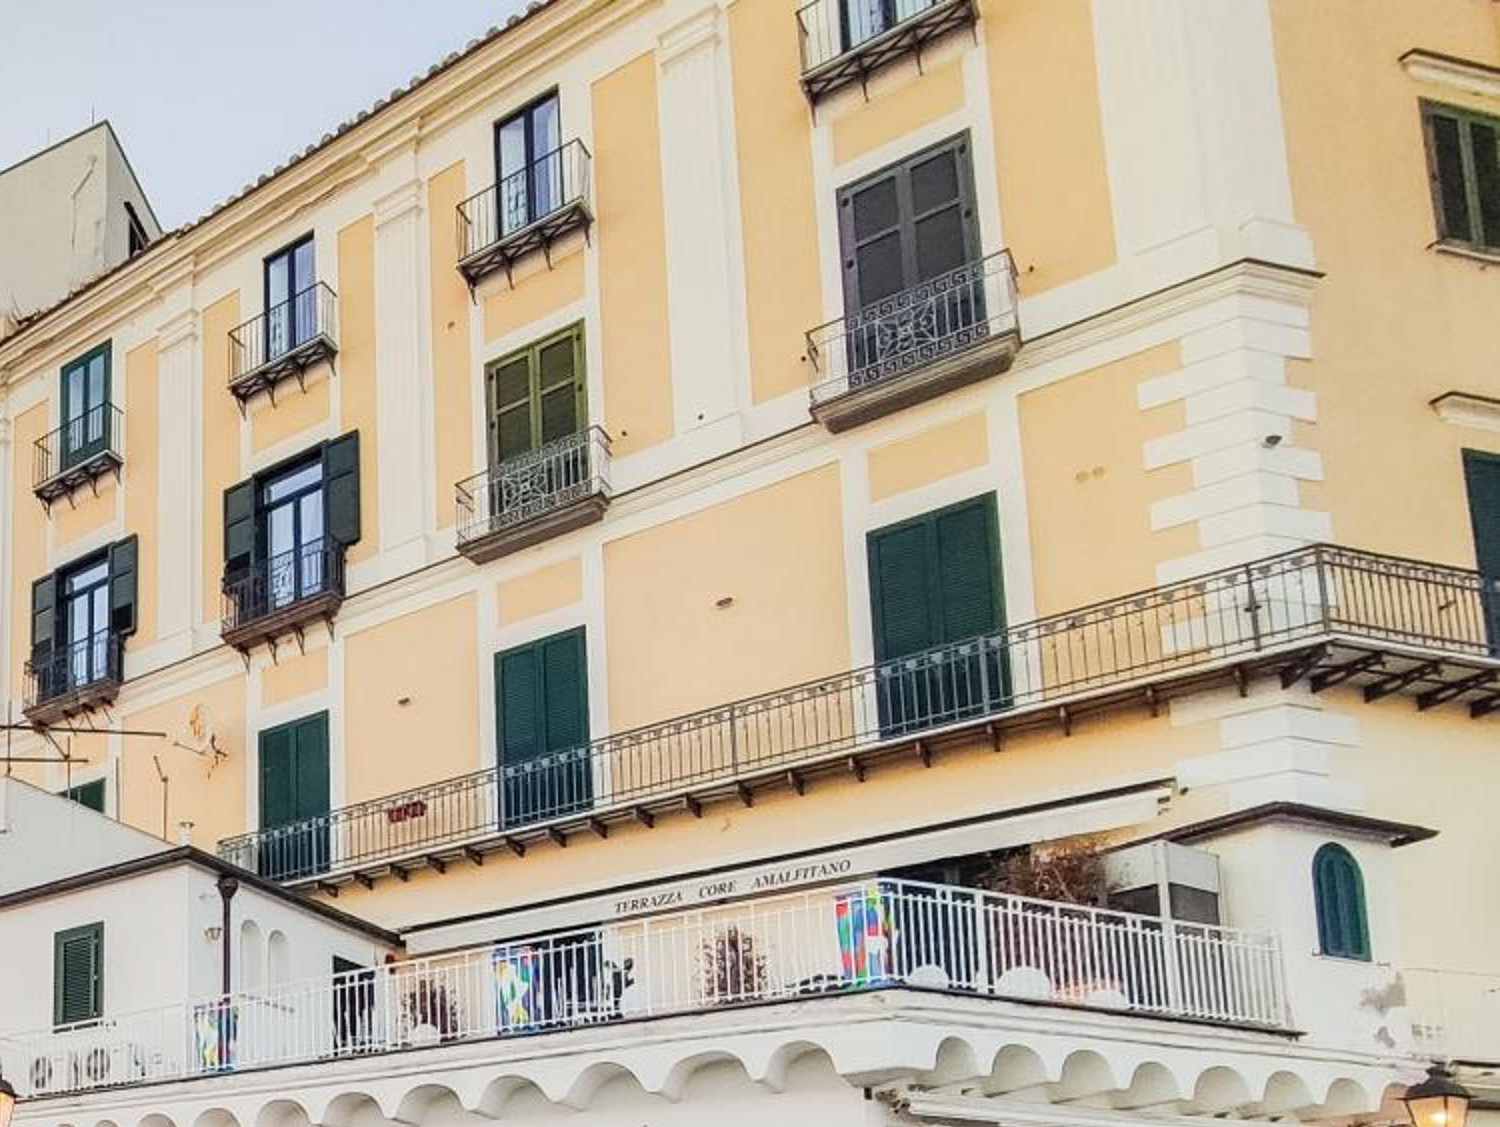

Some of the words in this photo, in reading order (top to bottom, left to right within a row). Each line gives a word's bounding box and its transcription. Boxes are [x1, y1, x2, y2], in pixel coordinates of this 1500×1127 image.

[614, 892, 682, 914] TERRAZZA
[699, 881, 737, 898] CORE
[752, 860, 851, 889] AMALFITANO
